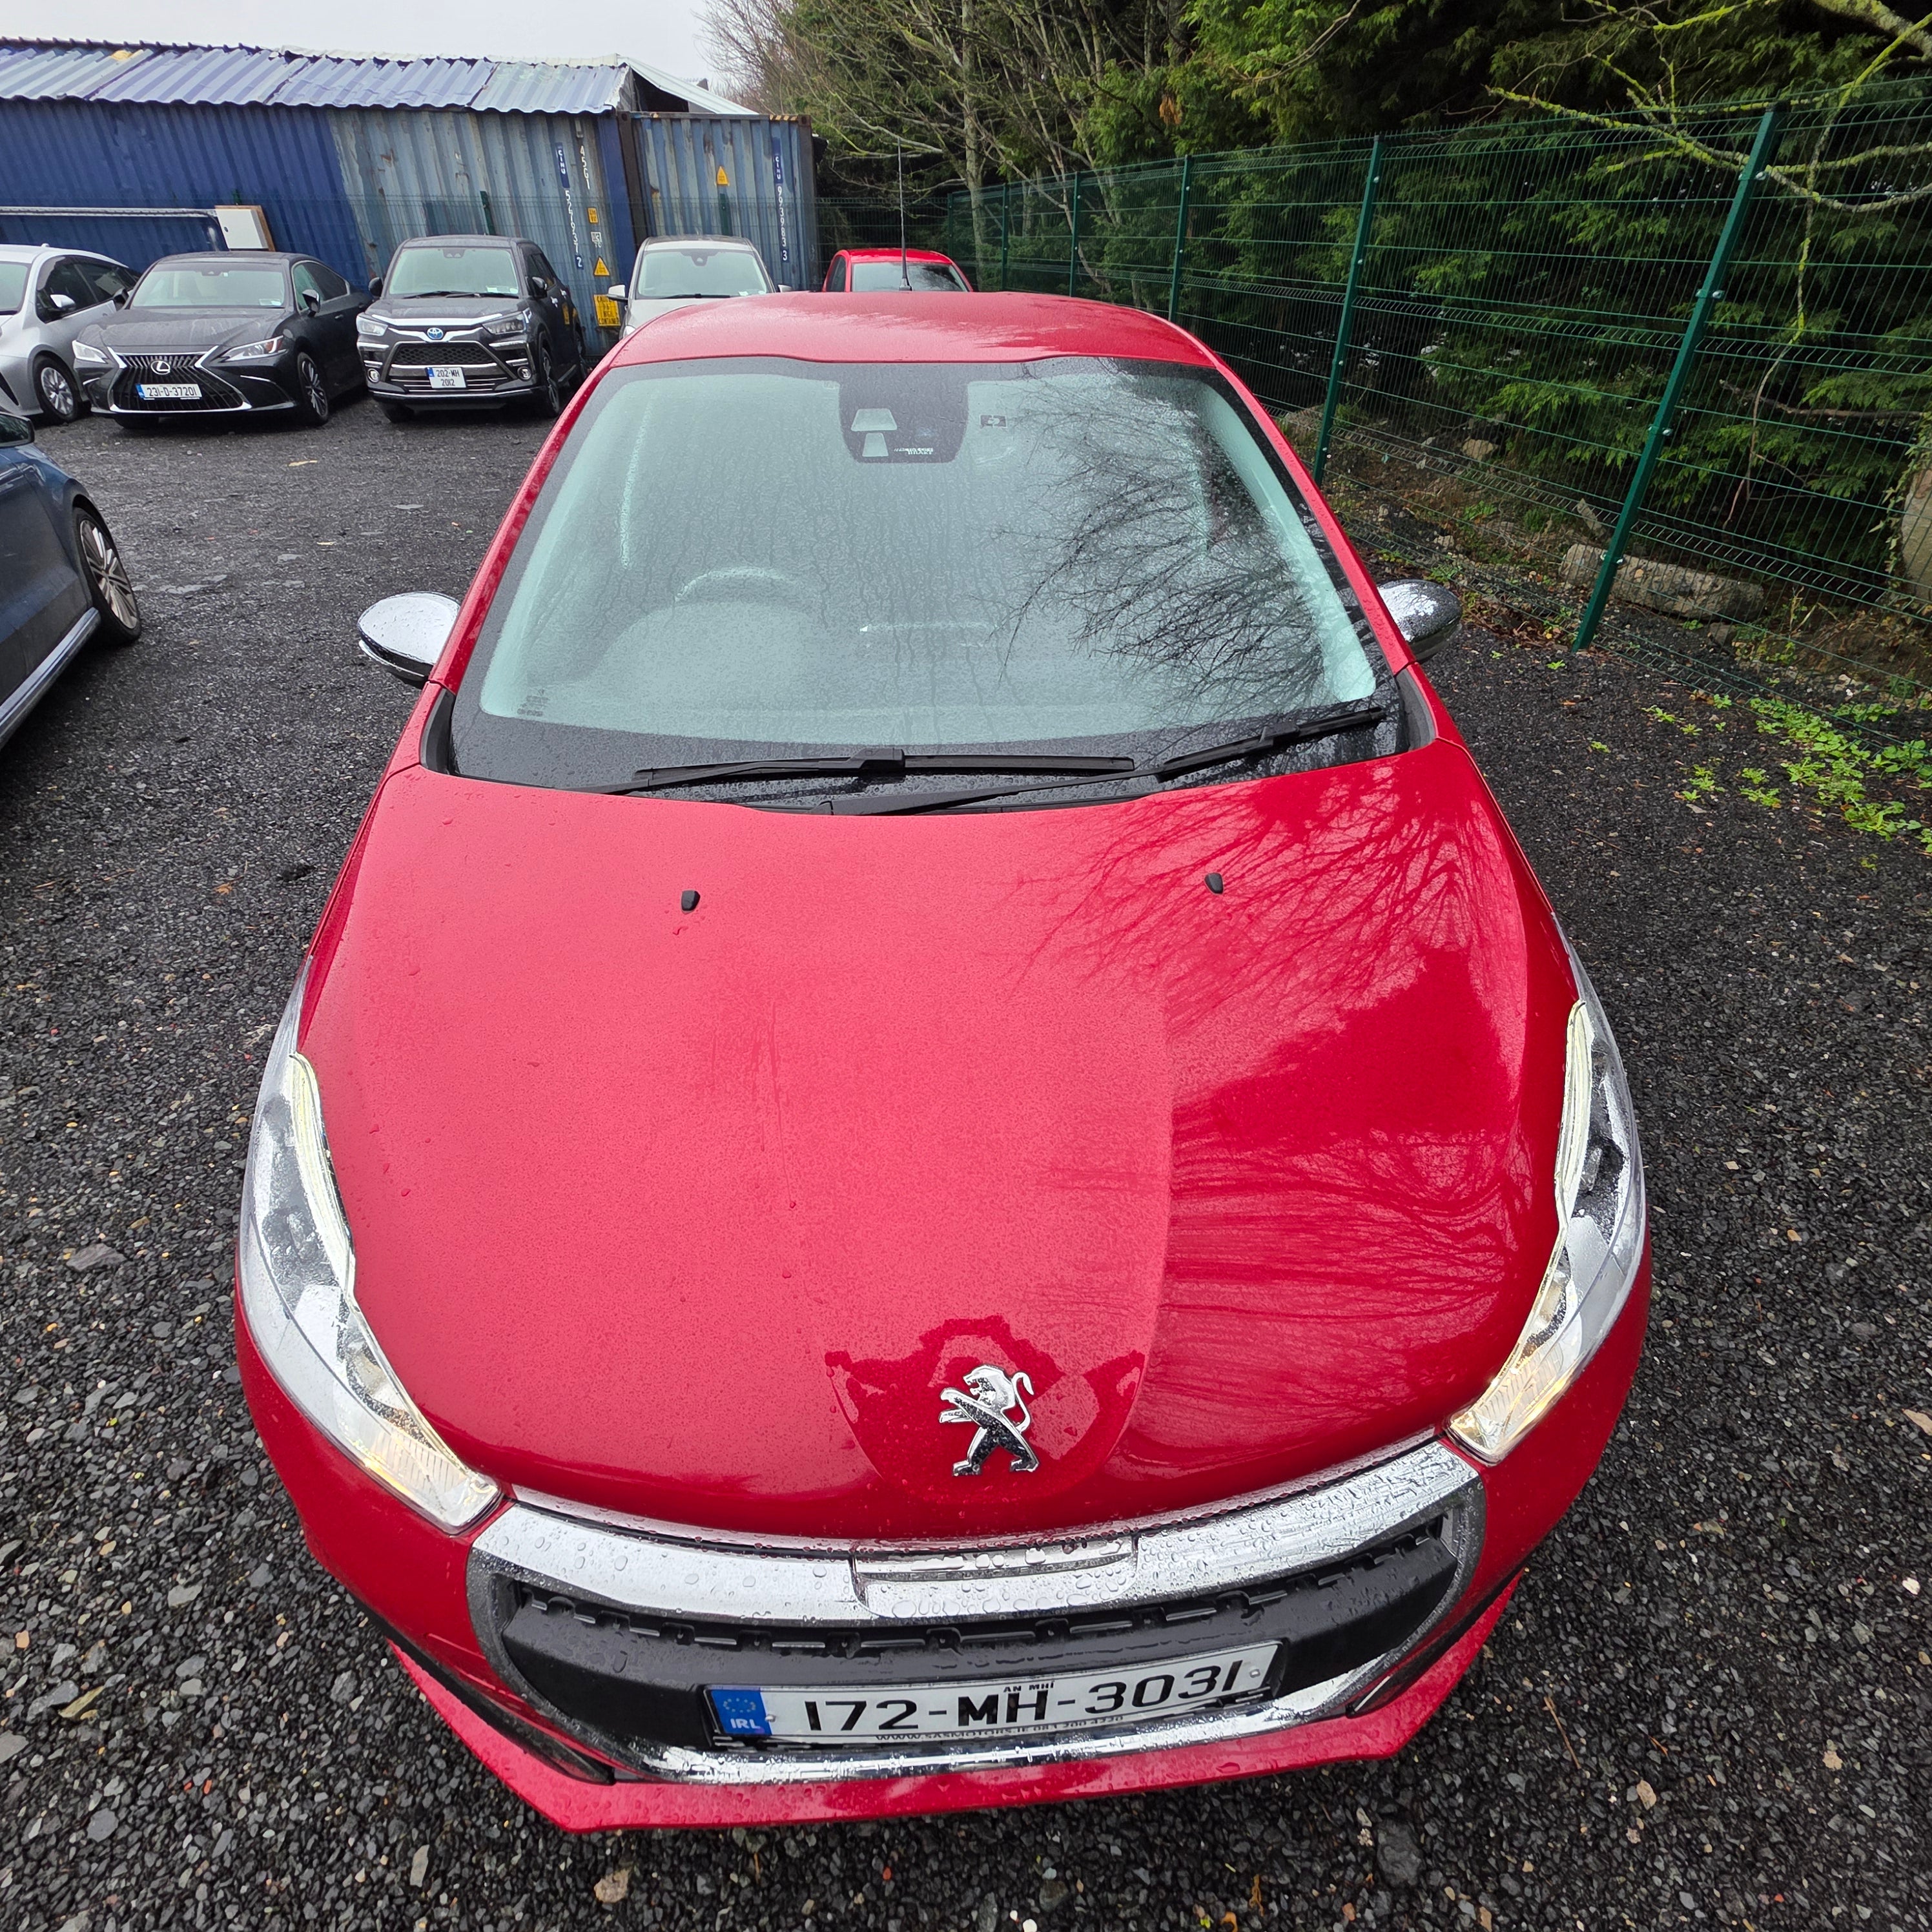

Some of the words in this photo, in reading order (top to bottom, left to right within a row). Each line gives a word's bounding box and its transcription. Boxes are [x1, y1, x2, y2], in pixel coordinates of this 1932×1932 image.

[147, 387, 197, 396] 231-D-37201
[805, 1660, 1243, 1731] 172-MH-3031
[730, 1718, 761, 1730] IRL
